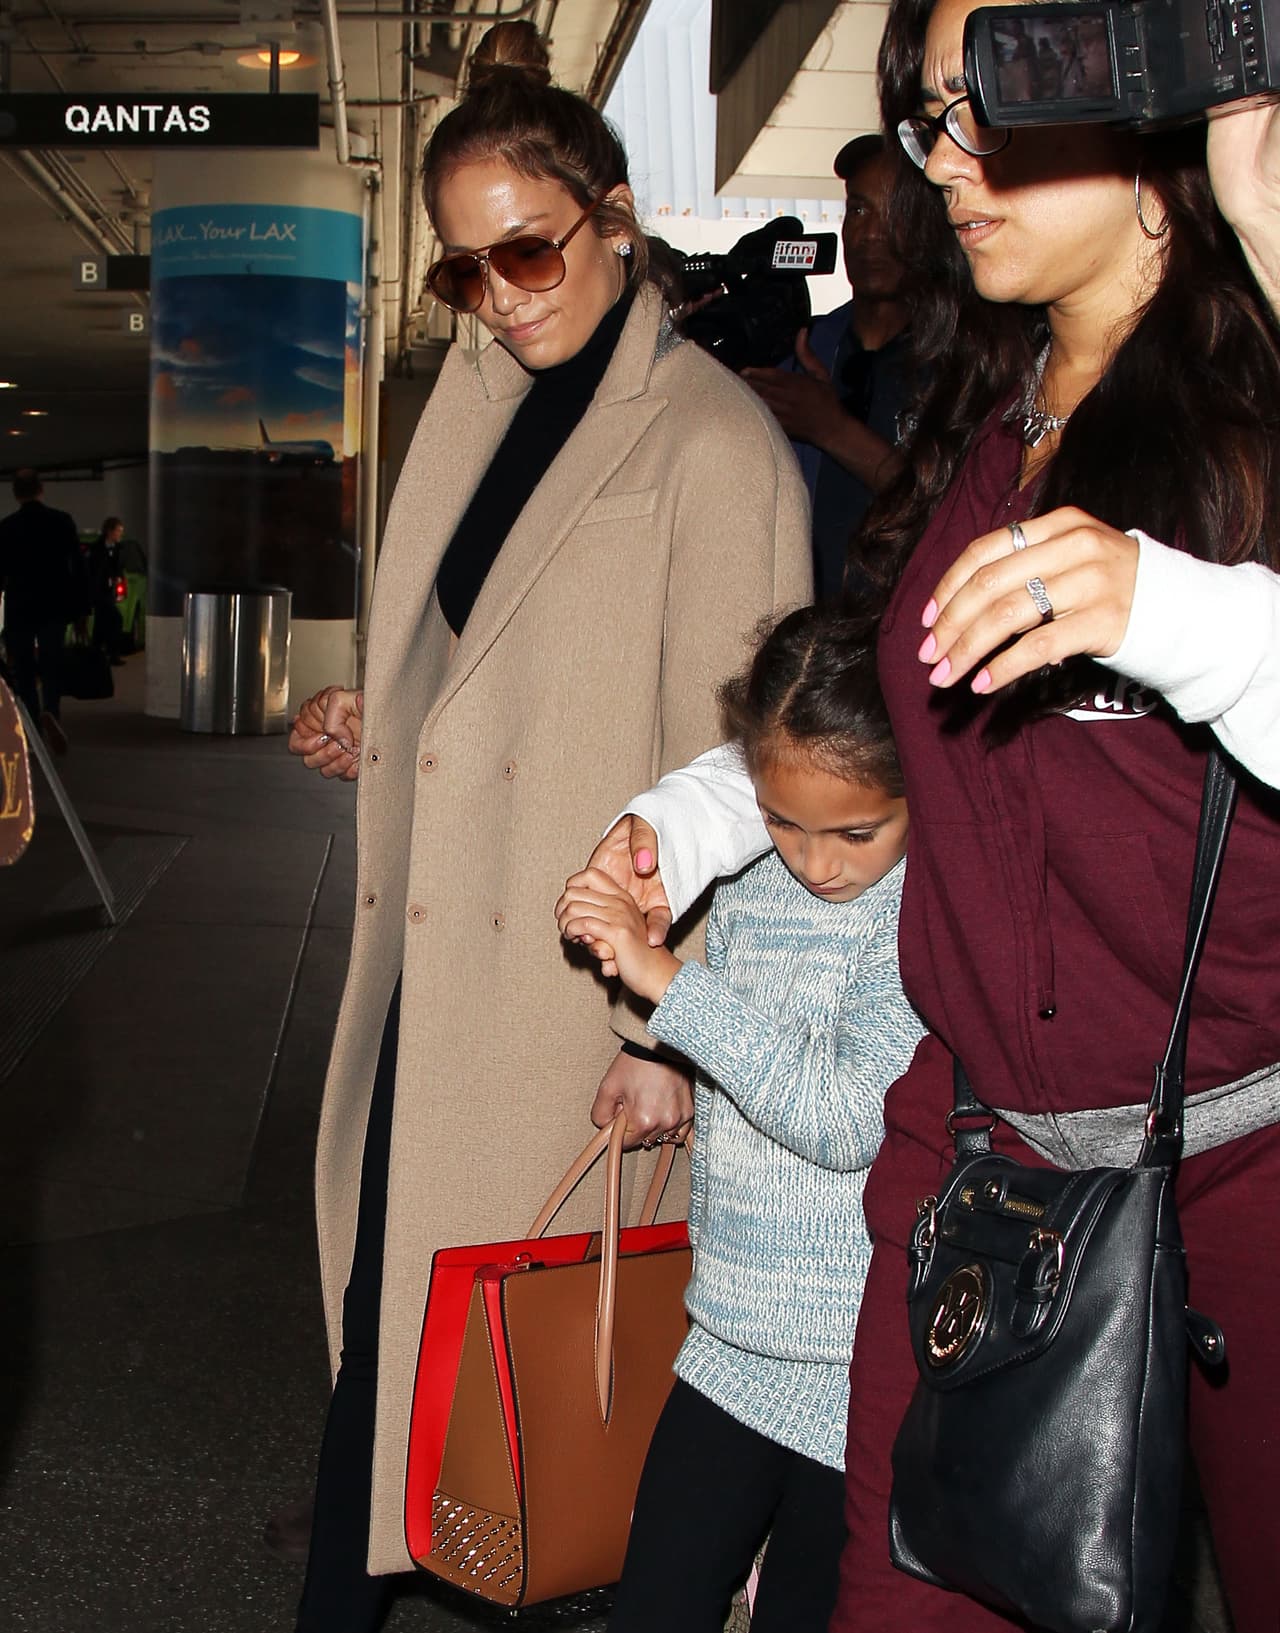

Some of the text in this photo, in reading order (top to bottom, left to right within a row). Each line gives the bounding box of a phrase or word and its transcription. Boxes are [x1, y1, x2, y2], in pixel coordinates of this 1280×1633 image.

[65, 105, 211, 133] QANTAS
[200, 219, 246, 241] Your
[249, 221, 297, 241] LAX
[81, 262, 98, 283] B
[129, 313, 144, 332] B
